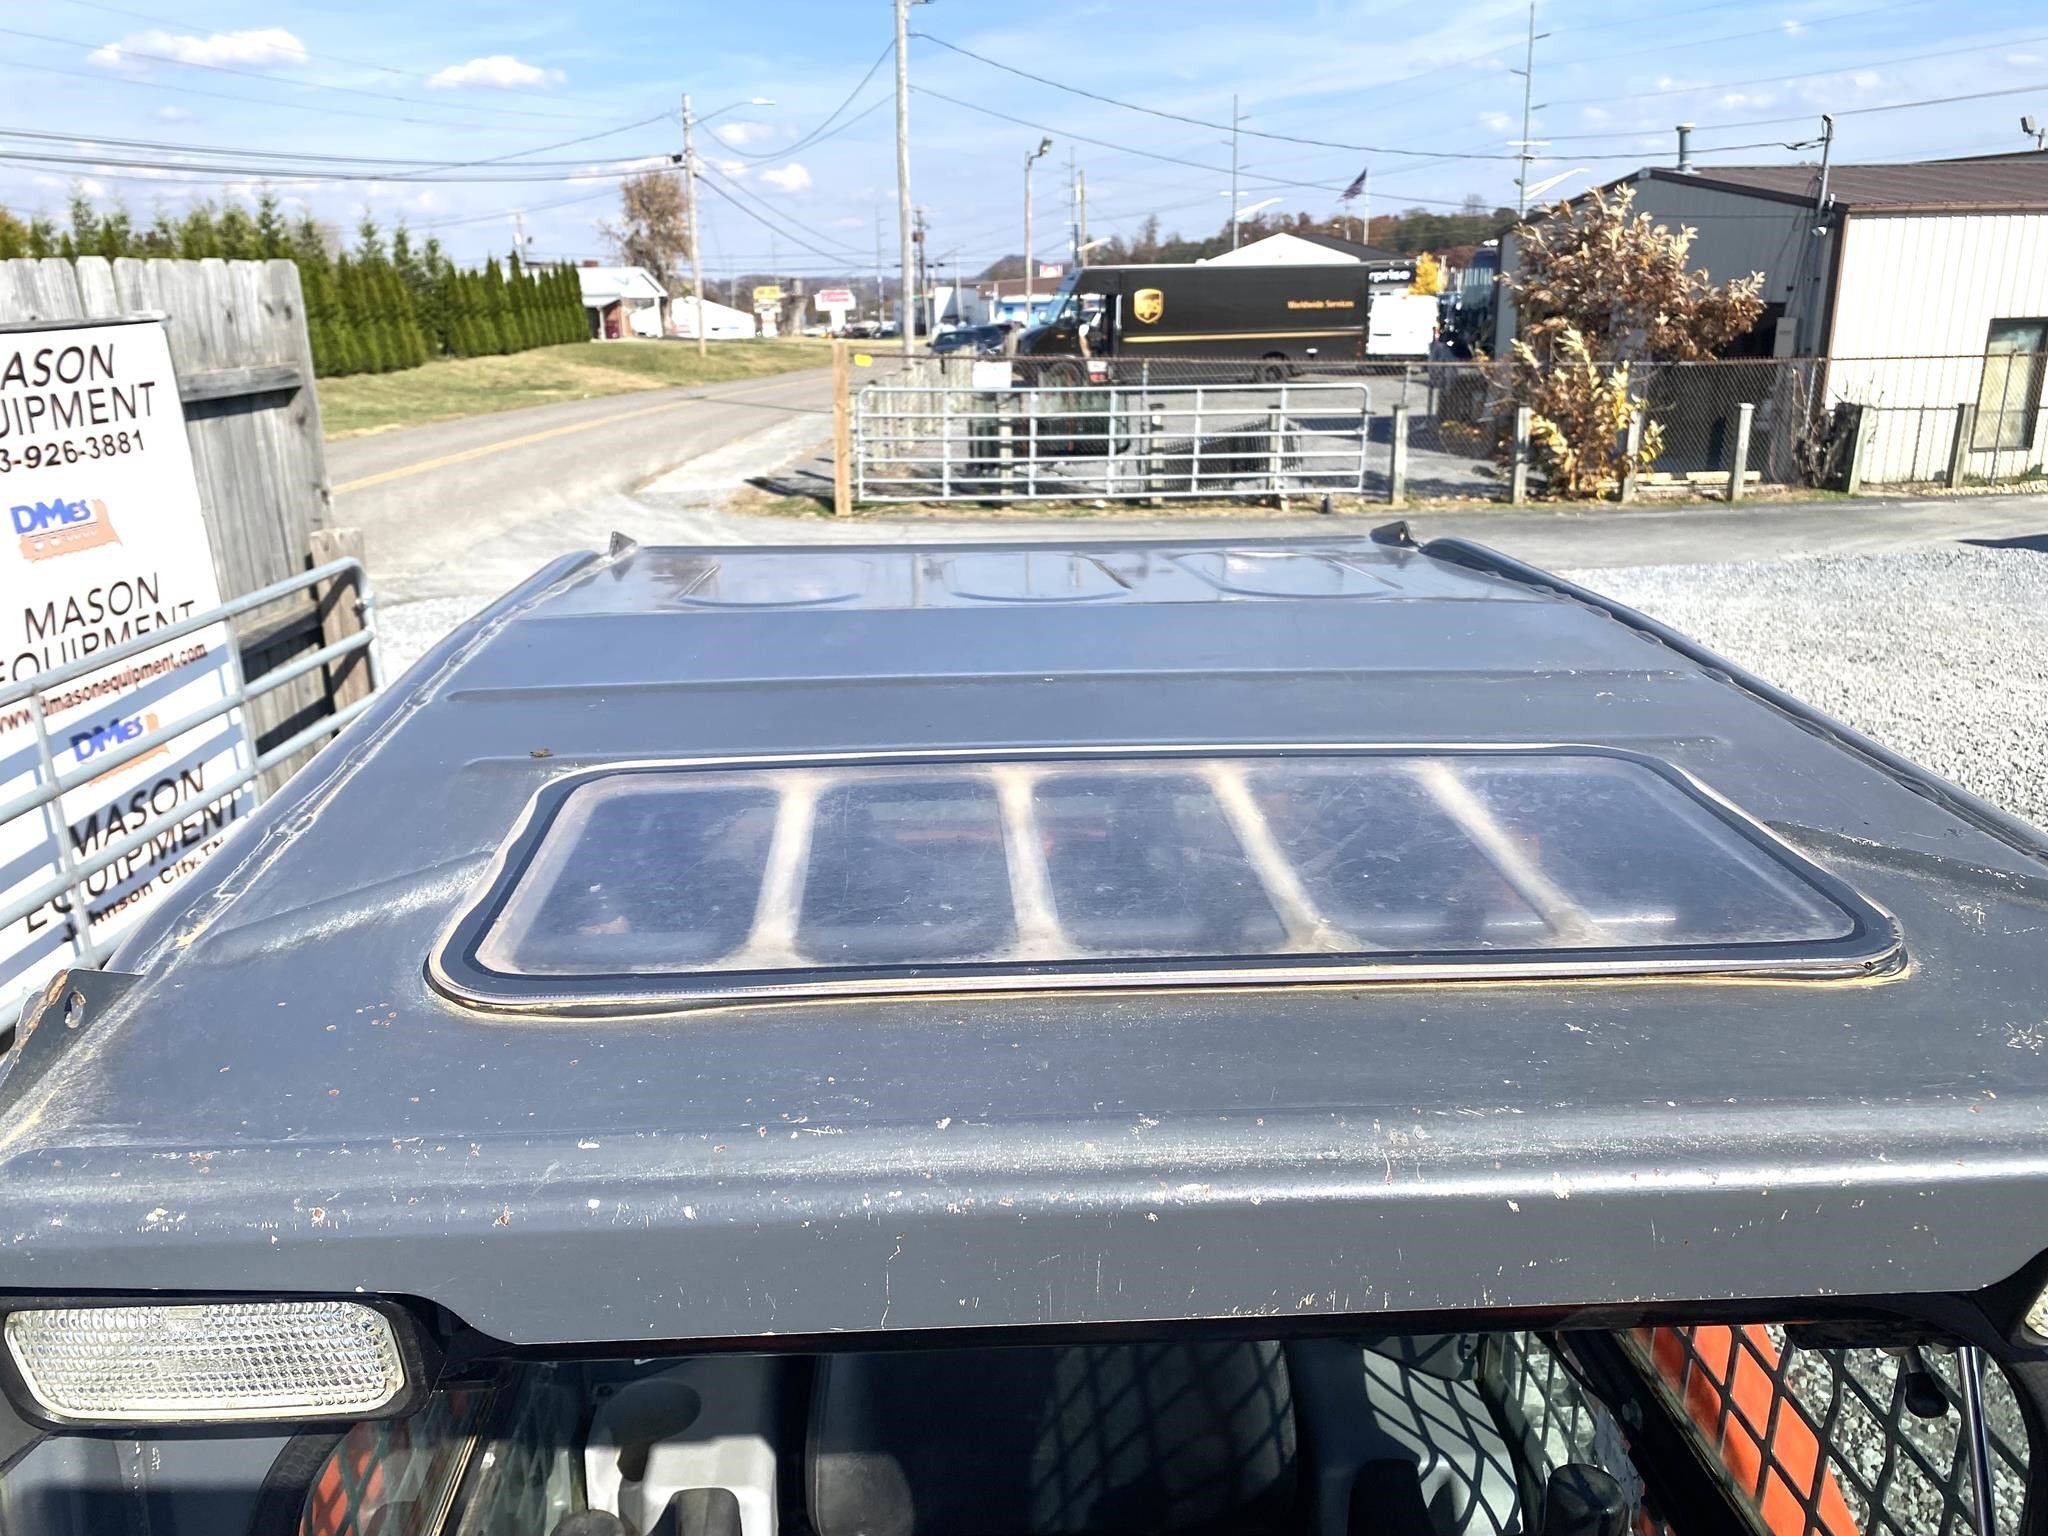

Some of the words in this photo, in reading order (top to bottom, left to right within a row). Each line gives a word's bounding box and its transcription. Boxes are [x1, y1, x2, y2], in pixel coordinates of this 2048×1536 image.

[1325, 300, 1354, 308] Services
[25, 572, 159, 643] MASON
[69, 762, 203, 857] MASON
[61, 881, 153, 942] Jhnson
